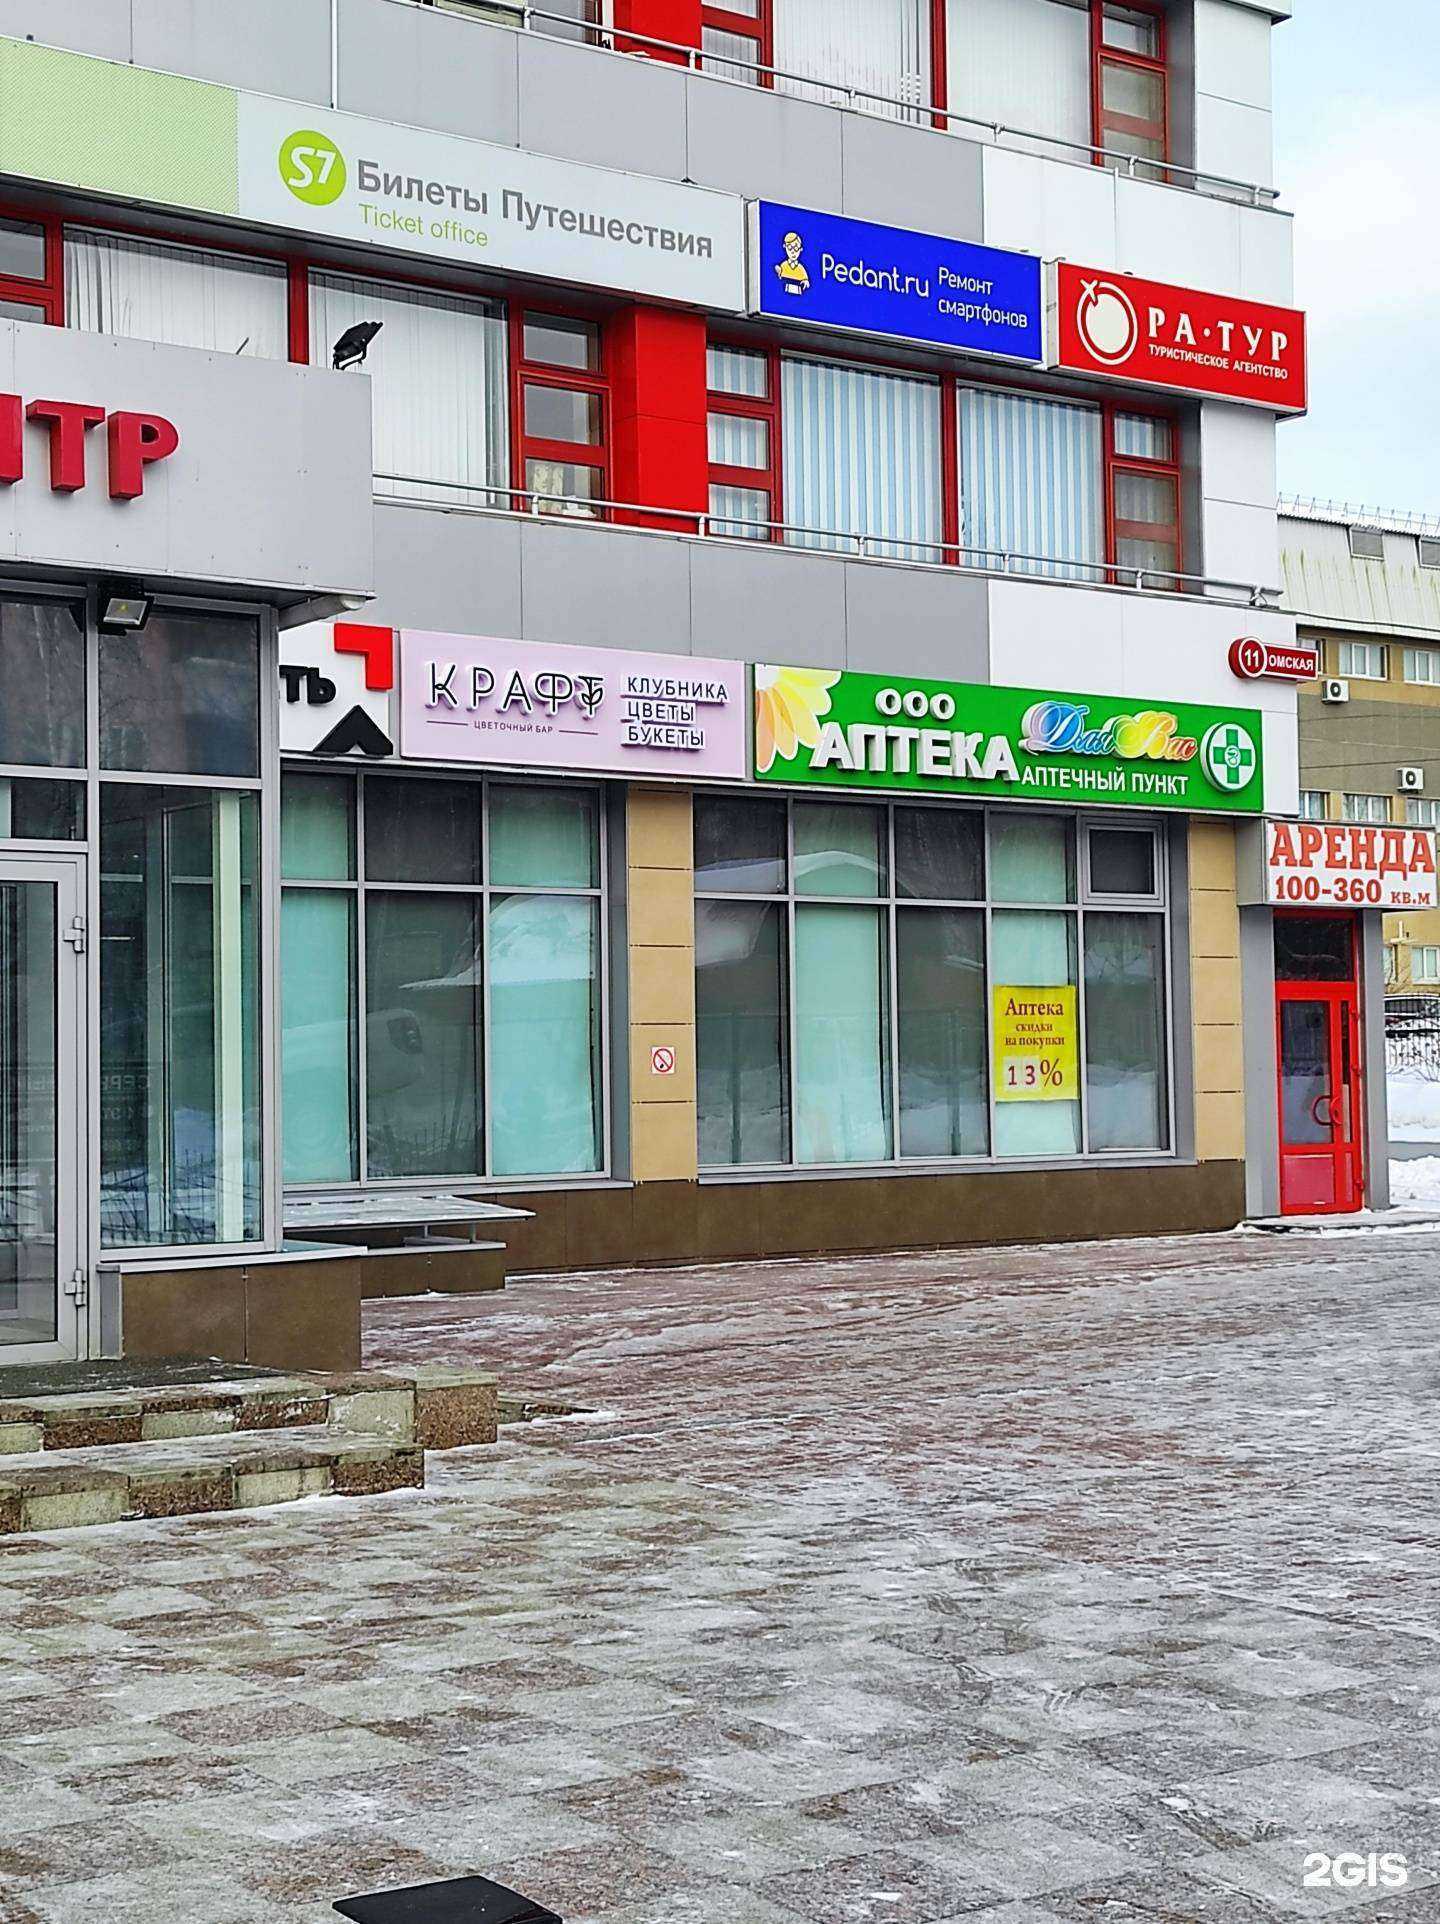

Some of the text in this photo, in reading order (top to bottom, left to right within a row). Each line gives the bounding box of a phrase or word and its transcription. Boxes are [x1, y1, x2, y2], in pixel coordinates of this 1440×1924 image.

[287, 146, 337, 189] S7
[356, 159, 714, 259] Билеты Путешествия
[359, 203, 489, 248] Ticket office
[821, 253, 930, 298] Pedant.ru
[938, 267, 994, 296] Ремонт
[937, 298, 1029, 328] смартфонов
[1148, 343, 1289, 380] ТУРИСТИЧЕСКОЕ АГЕНТСТВО
[1244, 648, 1314, 671] 11 ОМСКАЯ
[627, 676, 728, 700] КЛУБНИКА
[628, 701, 694, 721] ЦВЕТЫ
[474, 720, 553, 734] ЦВЕТОЧНЫЙ БАР
[628, 725, 704, 746] БУКЕТЫ
[1019, 700, 1198, 762] Для Вас
[809, 721, 1021, 782] АПТЕКА
[1021, 765, 1189, 796] АПТЕЧНЫЙ ПУНКТ
[1270, 822, 1435, 882] АРЕНДА
[1276, 875, 1382, 904] 100-360
[1005, 998, 1065, 1016] Аптека
[1015, 1023, 1053, 1032] скидки
[1005, 1036, 1065, 1049] на покупки
